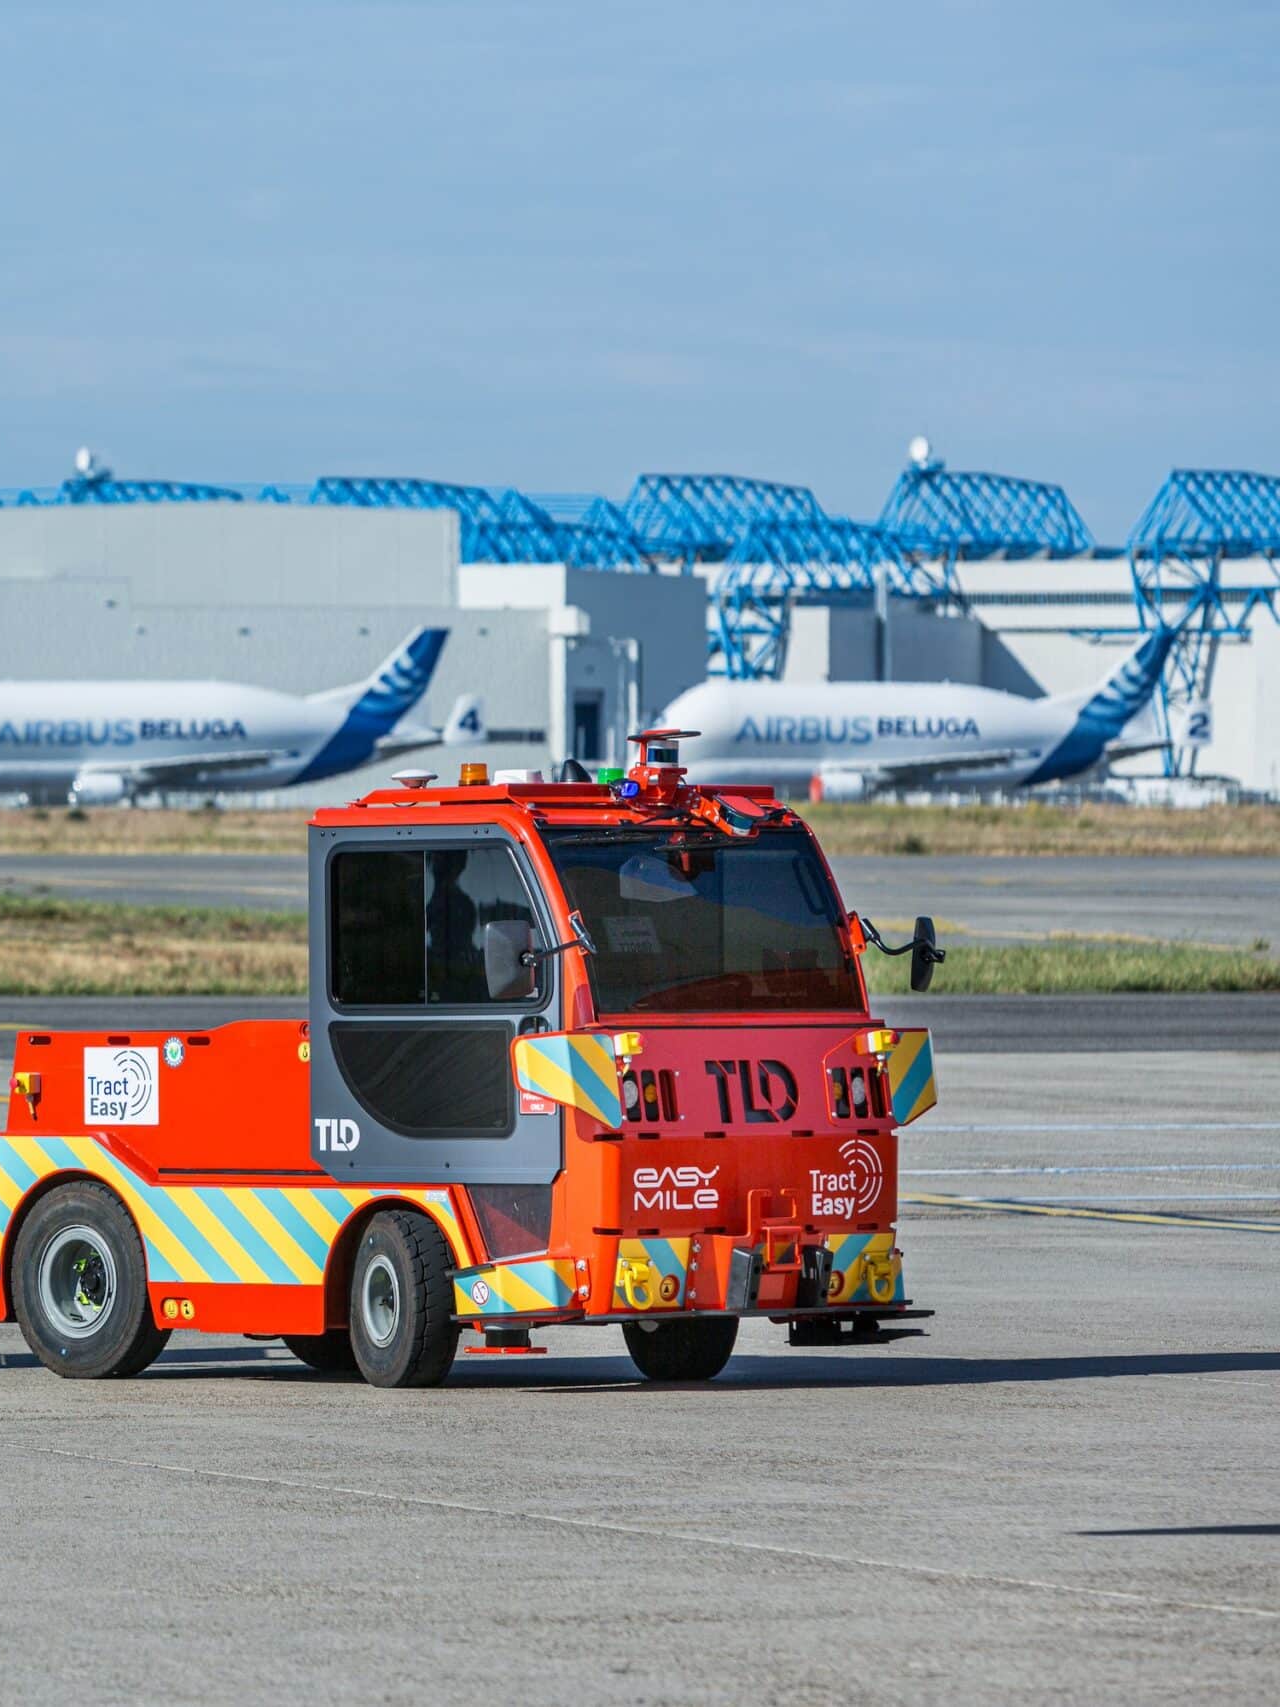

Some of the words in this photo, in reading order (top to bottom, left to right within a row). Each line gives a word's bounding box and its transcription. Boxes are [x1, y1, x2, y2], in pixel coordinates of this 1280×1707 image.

[138, 718, 248, 740] BELUGA
[458, 707, 482, 734] 4
[734, 715, 874, 744] AIRBUS
[877, 715, 981, 738] BELUGA
[1189, 712, 1209, 739] 2
[88, 1076, 129, 1096] Tract
[704, 1059, 798, 1123] TLD
[90, 1098, 127, 1120] Easy
[315, 1118, 361, 1152] TLD
[809, 1169, 857, 1192] Tract
[812, 1194, 856, 1220] Easy
